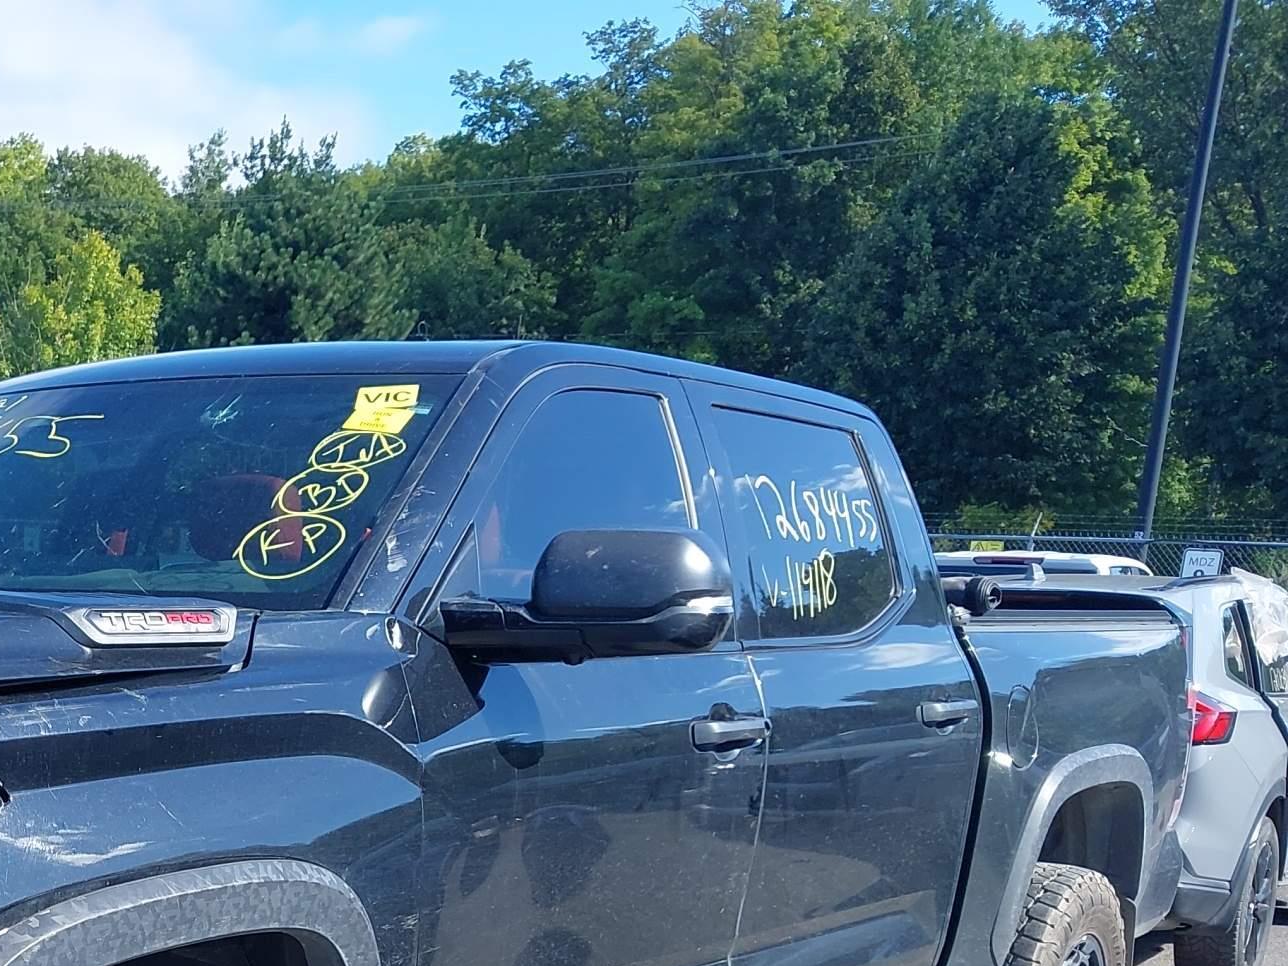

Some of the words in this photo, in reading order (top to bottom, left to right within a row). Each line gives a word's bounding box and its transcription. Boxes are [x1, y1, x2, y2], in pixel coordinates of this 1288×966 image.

[364, 391, 412, 404] VIC
[744, 473, 878, 548] 12684455
[1188, 555, 1216, 568] MDZ
